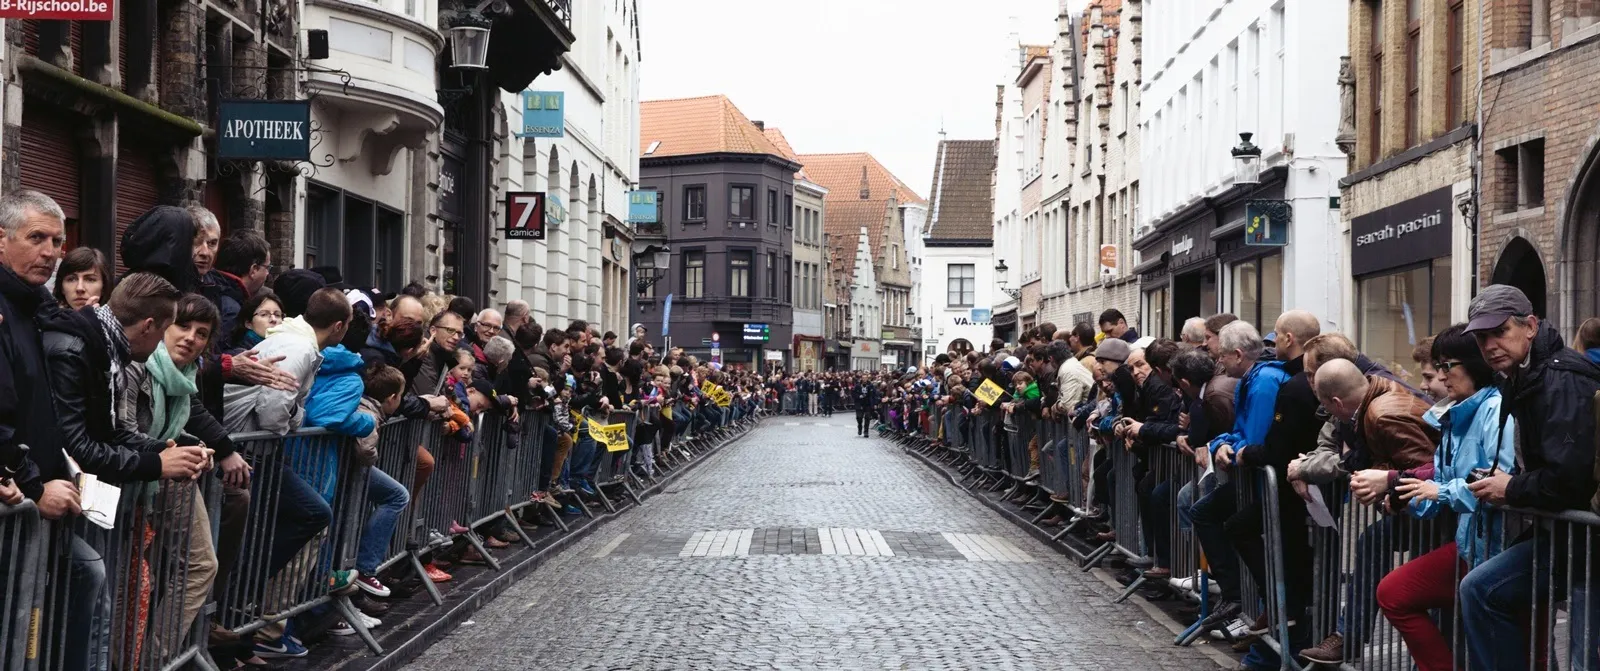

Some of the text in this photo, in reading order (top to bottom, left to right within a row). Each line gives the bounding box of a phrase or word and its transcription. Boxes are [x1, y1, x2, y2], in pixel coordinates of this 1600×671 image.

[0, 0, 107, 15] B-Rijschool.be
[224, 119, 304, 140] APOTHEEK
[525, 125, 561, 134] ESSENZA
[514, 196, 537, 228] 7
[509, 228, 541, 237] camicie
[1356, 209, 1441, 247] sarah pacini
